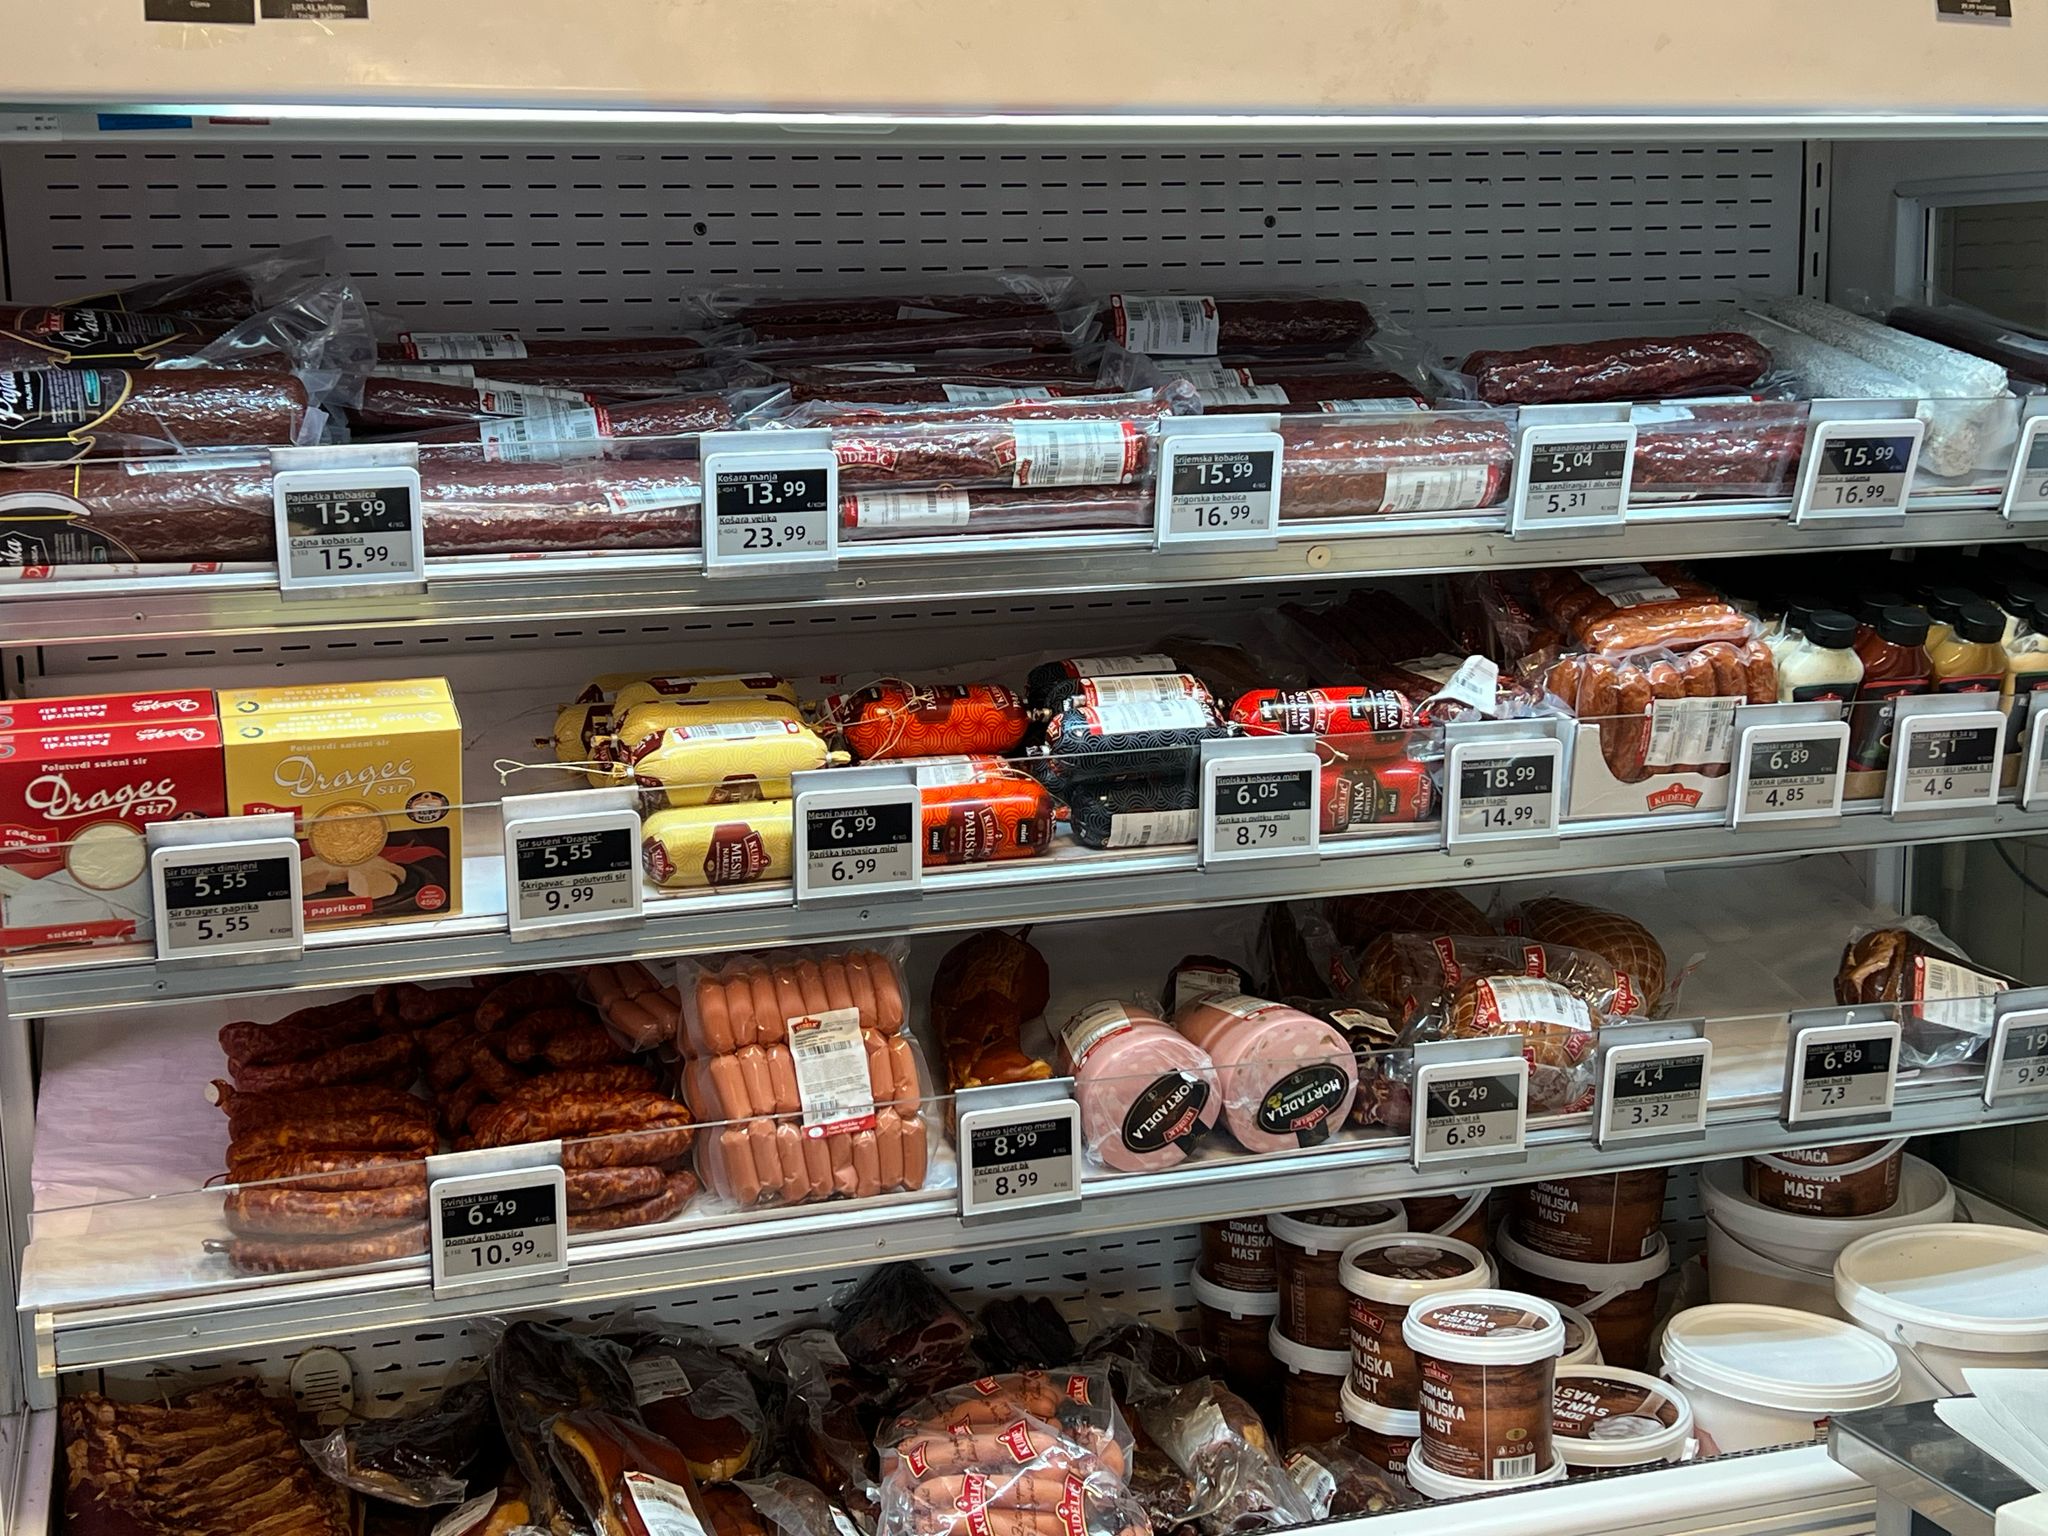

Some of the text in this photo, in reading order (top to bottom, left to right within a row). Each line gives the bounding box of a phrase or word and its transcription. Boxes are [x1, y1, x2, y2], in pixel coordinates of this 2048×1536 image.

[1174, 454, 1249, 464] Srijemska kobasica
[1552, 452, 1593, 473] 5.04
[1843, 447, 1894, 466] 15.99
[718, 472, 778, 483] Košara manja
[1197, 463, 1253, 485] 15.99
[286, 491, 376, 503] Pajdaška kobasica
[743, 481, 806, 505] 13.99
[1173, 494, 1247, 505] Prigorska kobasica
[1547, 493, 1586, 513] 5.31
[1835, 485, 1885, 504] 16.99
[316, 500, 386, 524] 15.99
[719, 515, 777, 525] Košara velika
[1195, 505, 1250, 527] 16.99
[322, 536, 364, 546] kobasica
[743, 526, 806, 549] 23.99
[320, 546, 388, 570] 15.99
[1929, 740, 1956, 759] 5.1
[41, 757, 148, 772] Polutvrdi sušeni sir
[1770, 750, 1809, 770] 6.89
[274, 753, 416, 797] Dragec
[1247, 775, 1281, 783] kobasica
[1282, 773, 1300, 781] mini
[1483, 766, 1535, 788] 18.99
[25, 773, 176, 819] Dragec
[376, 784, 407, 796] sir
[1237, 783, 1278, 805] 6.05
[1924, 777, 1953, 795] 4.6
[1766, 788, 1804, 807] 4.85
[135, 801, 169, 816] sir
[808, 808, 869, 819] Mesni narezak
[1481, 806, 1533, 827] 14.99
[831, 817, 876, 839] 6.99
[1236, 824, 1277, 845] 8.79
[518, 841, 529, 849] Sir
[531, 838, 560, 847] sušeni
[809, 845, 898, 859] Pariška kobasica mini
[544, 844, 592, 868] 5.55
[165, 862, 258, 877] Sir Dragec dimljeni
[832, 859, 876, 881] 6.99
[195, 873, 247, 897] 5.55
[521, 880, 563, 890] Škripavac
[573, 875, 613, 886] polutvrdi
[545, 887, 593, 911] 9.99
[185, 907, 219, 917] Dragec
[221, 904, 259, 914] paprika
[311, 903, 367, 917] paprikom
[46, 928, 88, 940] sušeni
[198, 916, 249, 940] 5.55
[1824, 1050, 1862, 1070] 6.89
[1634, 1064, 1663, 1088] 4.4
[1266, 1078, 1341, 1122] MORTADELA
[1448, 1086, 1488, 1108] 6.49
[1821, 1087, 1845, 1105] 7.3
[1631, 1104, 1669, 1124] 3.32
[1002, 1124, 1033, 1136] sječeno
[1034, 1121, 1056, 1130] meso
[1446, 1124, 1486, 1145] 6.89
[994, 1132, 1037, 1156] 8.99
[974, 1164, 1017, 1176] Pečeni vrat
[996, 1172, 1038, 1196] 8.99
[1537, 1182, 1570, 1198] DOMAĆA
[1783, 1179, 1825, 1200] MAST
[442, 1194, 498, 1208] Svinjski kare
[1530, 1189, 1579, 1214] SVINJSKA
[468, 1200, 517, 1225] 6.49
[1538, 1207, 1567, 1225] MAST
[1229, 1221, 1264, 1234] DOMAĆA
[445, 1230, 524, 1247] Domaća kobasica
[1220, 1229, 1274, 1247] SVINJSKA
[471, 1240, 535, 1267] 10.99
[1231, 1247, 1262, 1261] MAST
[1423, 1380, 1454, 1402] DOMAĆA
[1554, 1386, 1600, 1404] MAST
[1426, 1413, 1453, 1435] MAST
